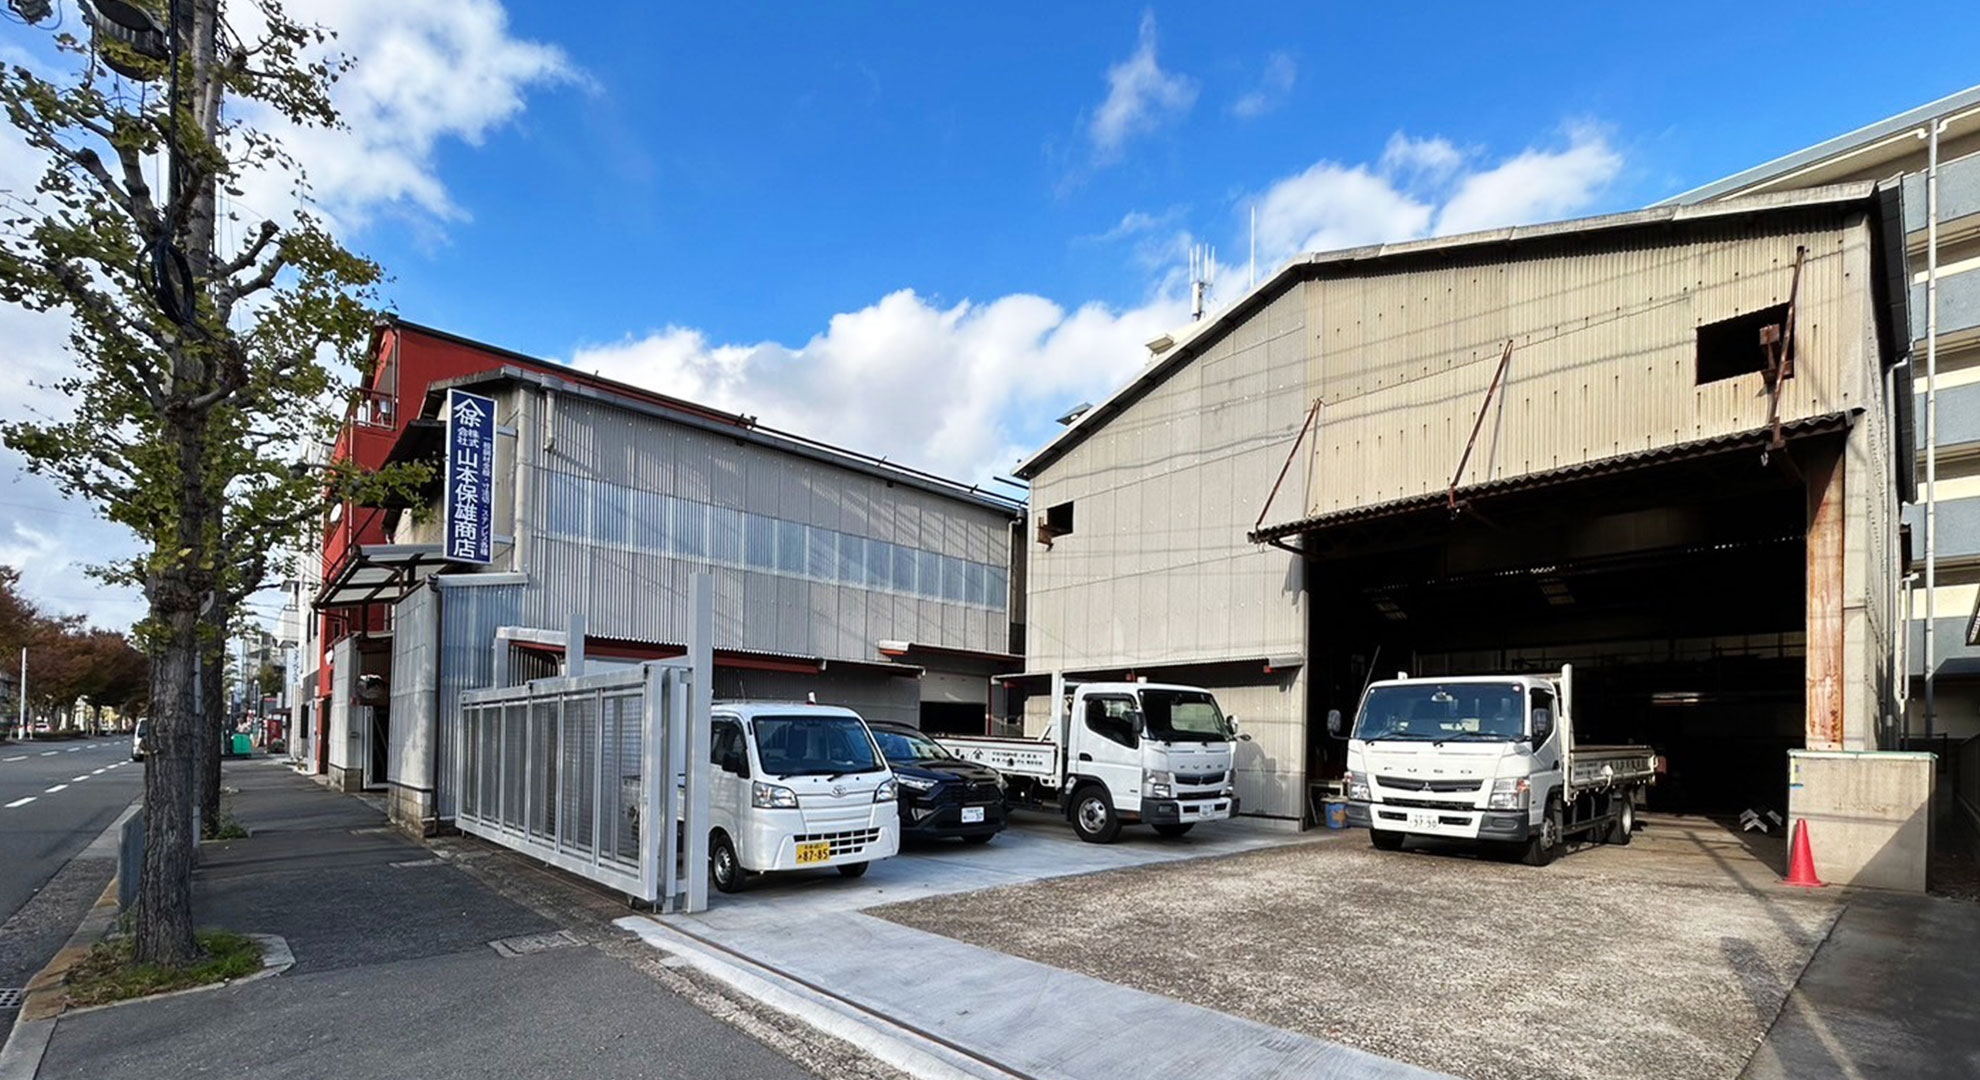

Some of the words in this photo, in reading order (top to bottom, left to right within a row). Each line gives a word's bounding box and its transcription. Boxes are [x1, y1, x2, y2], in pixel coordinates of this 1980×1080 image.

[453, 447, 479, 560] 山本保雄商店
